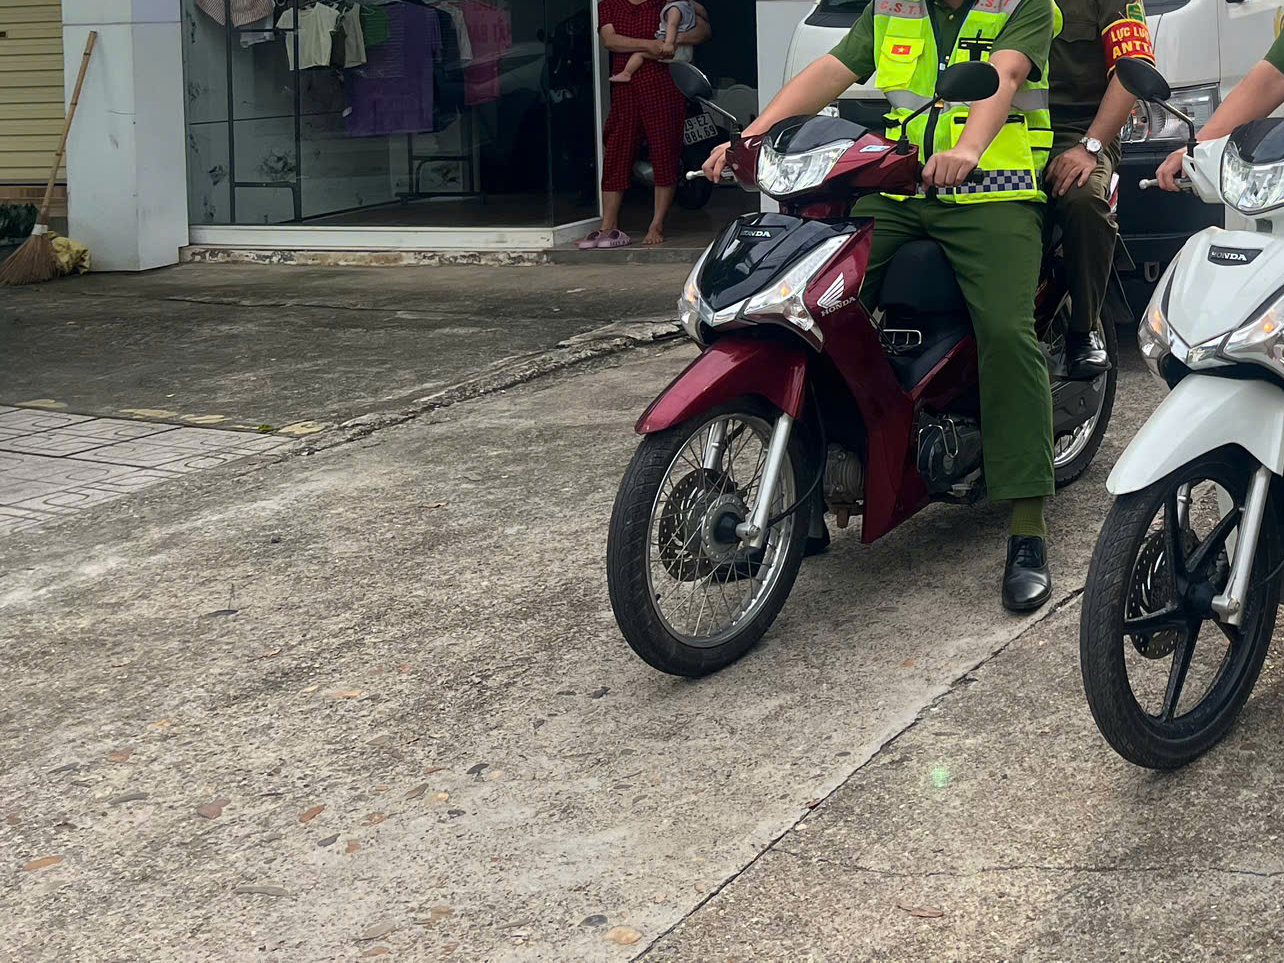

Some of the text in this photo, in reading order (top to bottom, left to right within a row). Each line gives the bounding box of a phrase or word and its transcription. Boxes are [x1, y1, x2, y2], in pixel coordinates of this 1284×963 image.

[740, 230, 771, 238] ONDA
[1211, 251, 1248, 261] HONDA
[821, 296, 857, 317] HONDA
